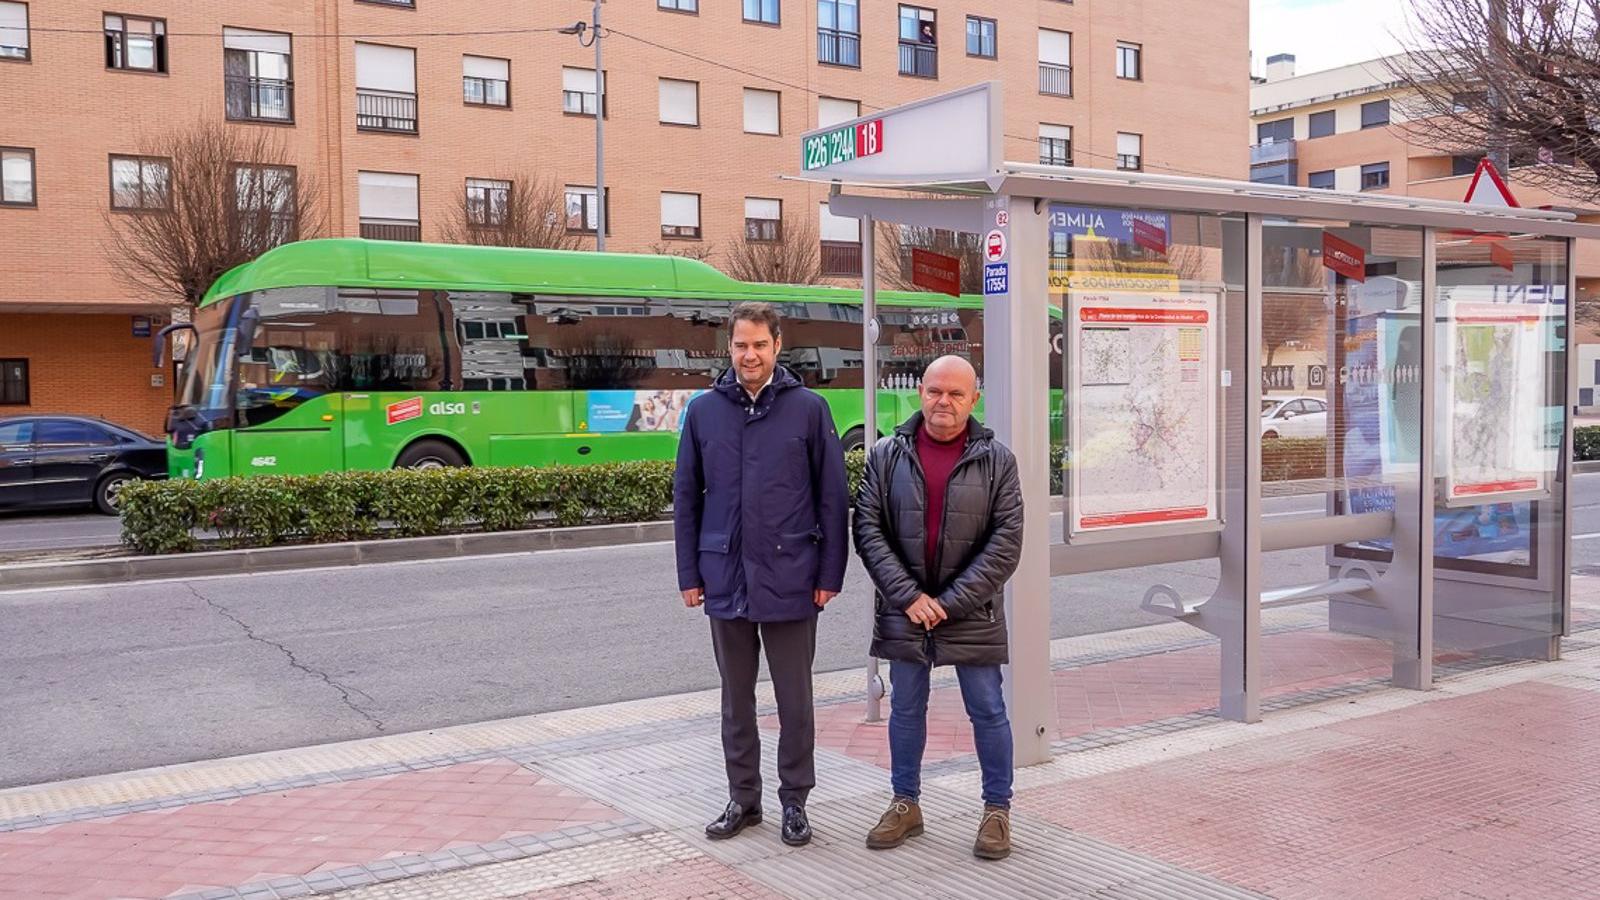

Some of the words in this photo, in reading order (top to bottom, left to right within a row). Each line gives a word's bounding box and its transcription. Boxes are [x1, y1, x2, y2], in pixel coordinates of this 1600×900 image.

[807, 135, 828, 170] 226
[831, 127, 854, 164] 224A
[862, 122, 877, 155] 1B
[986, 266, 1007, 277] Parada
[986, 277, 1006, 292] 17554
[429, 401, 465, 415] alsa
